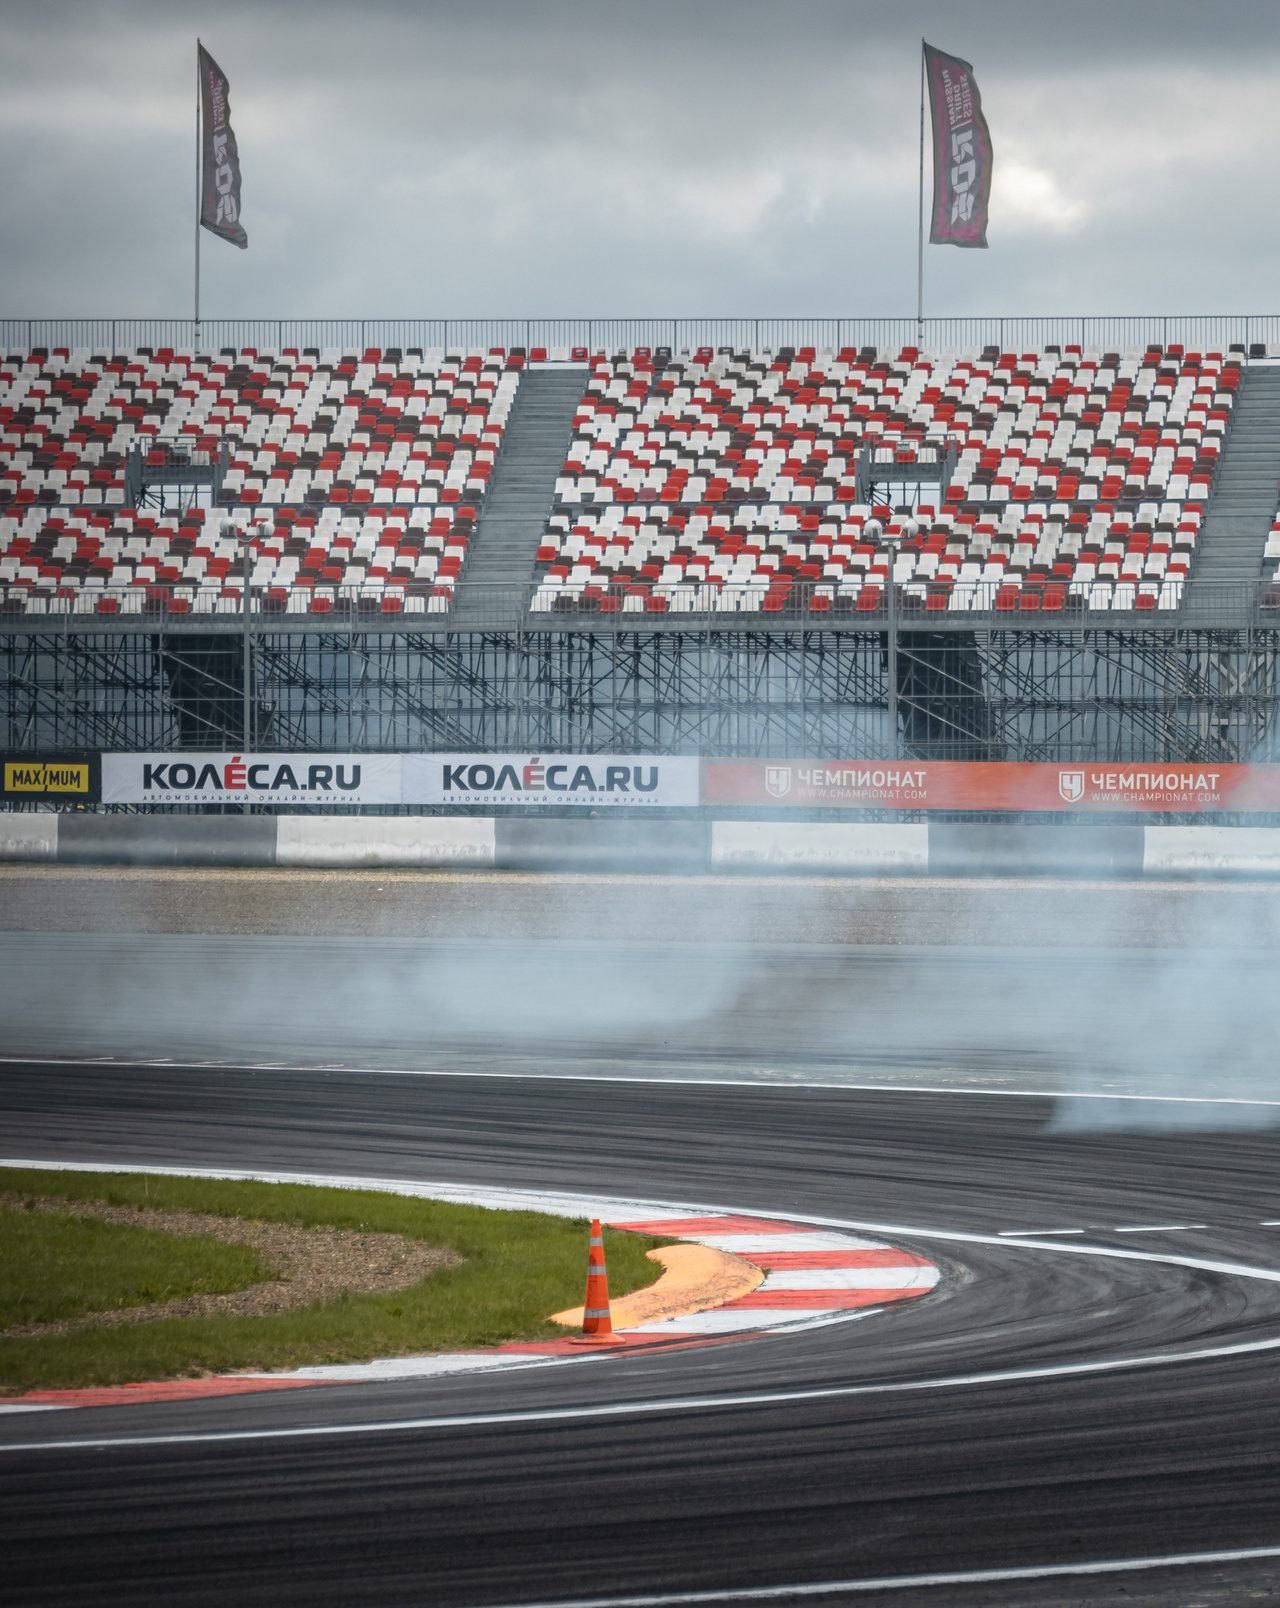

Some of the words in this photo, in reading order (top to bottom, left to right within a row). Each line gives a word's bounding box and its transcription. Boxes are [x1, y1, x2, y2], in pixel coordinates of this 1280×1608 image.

[12, 769, 81, 789] MAXIMUM
[797, 769, 927, 788] ЧЕМПИОНАТ
[1091, 773, 1220, 790] ЧЕМПИОНАТ
[1091, 792, 1220, 802] WWW.CHAMPIONAT.COM
